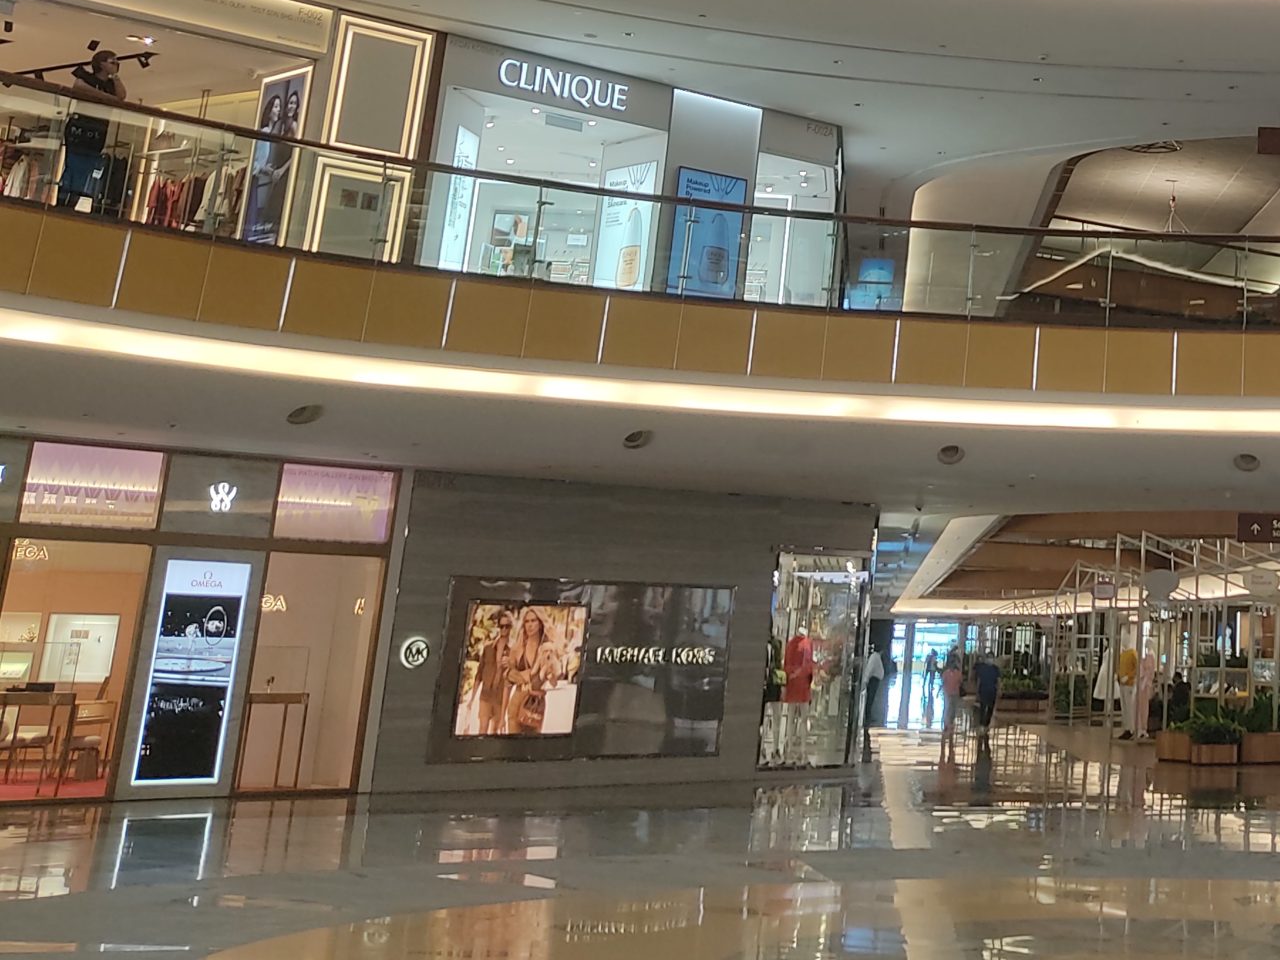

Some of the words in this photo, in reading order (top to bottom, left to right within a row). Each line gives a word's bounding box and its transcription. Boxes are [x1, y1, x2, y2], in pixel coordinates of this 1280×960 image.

[499, 58, 629, 111] CLINIQUE
[686, 177, 709, 188] Makeup
[685, 185, 711, 194] Powered
[190, 579, 223, 589] OMEGA
